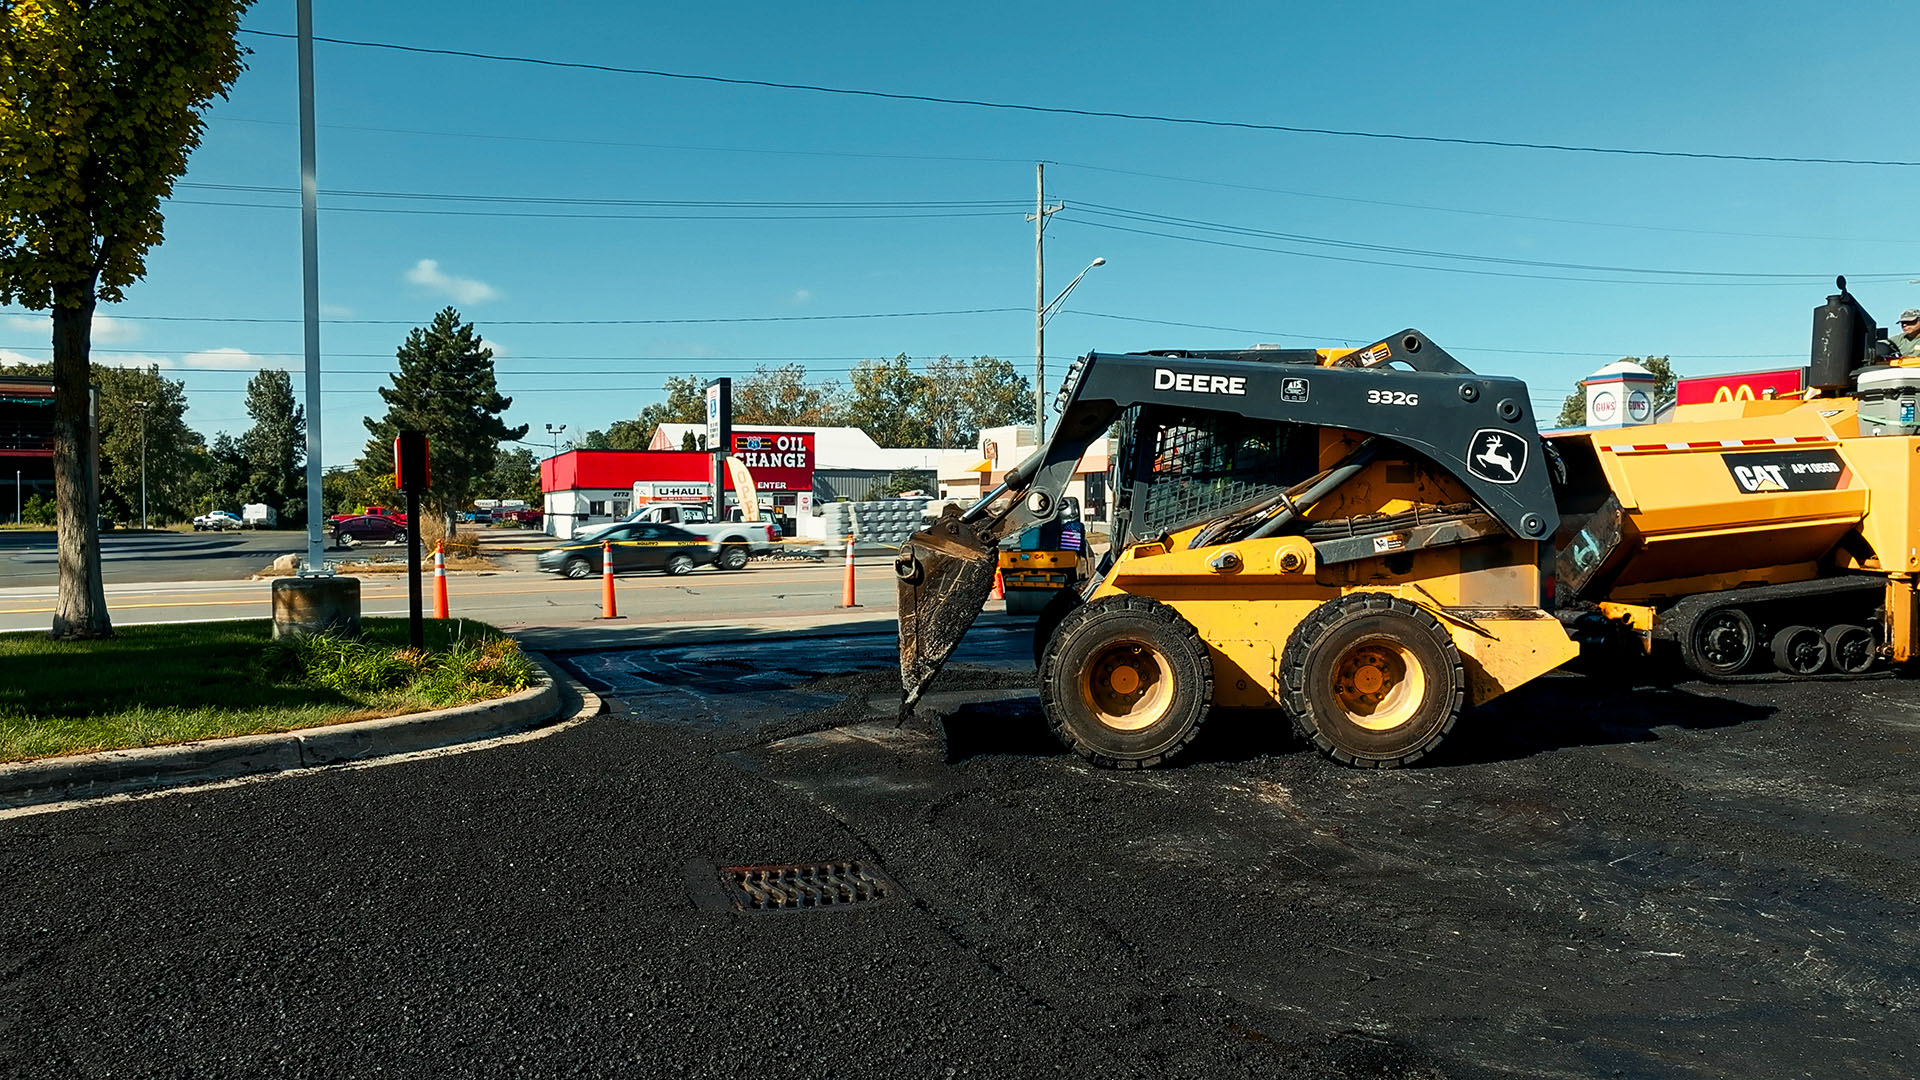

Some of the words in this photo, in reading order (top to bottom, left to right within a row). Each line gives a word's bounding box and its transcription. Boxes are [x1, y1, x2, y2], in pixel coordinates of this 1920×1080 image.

[1154, 368, 1246, 395] DEERE
[1367, 389, 1419, 406] 332G
[1628, 400, 1646, 411] GUNS
[1595, 401, 1616, 412] GUNS
[777, 435, 806, 452] OIL
[757, 481, 787, 489] ENTER
[1734, 464, 1789, 491] CAT
[736, 471, 758, 521] OPE
